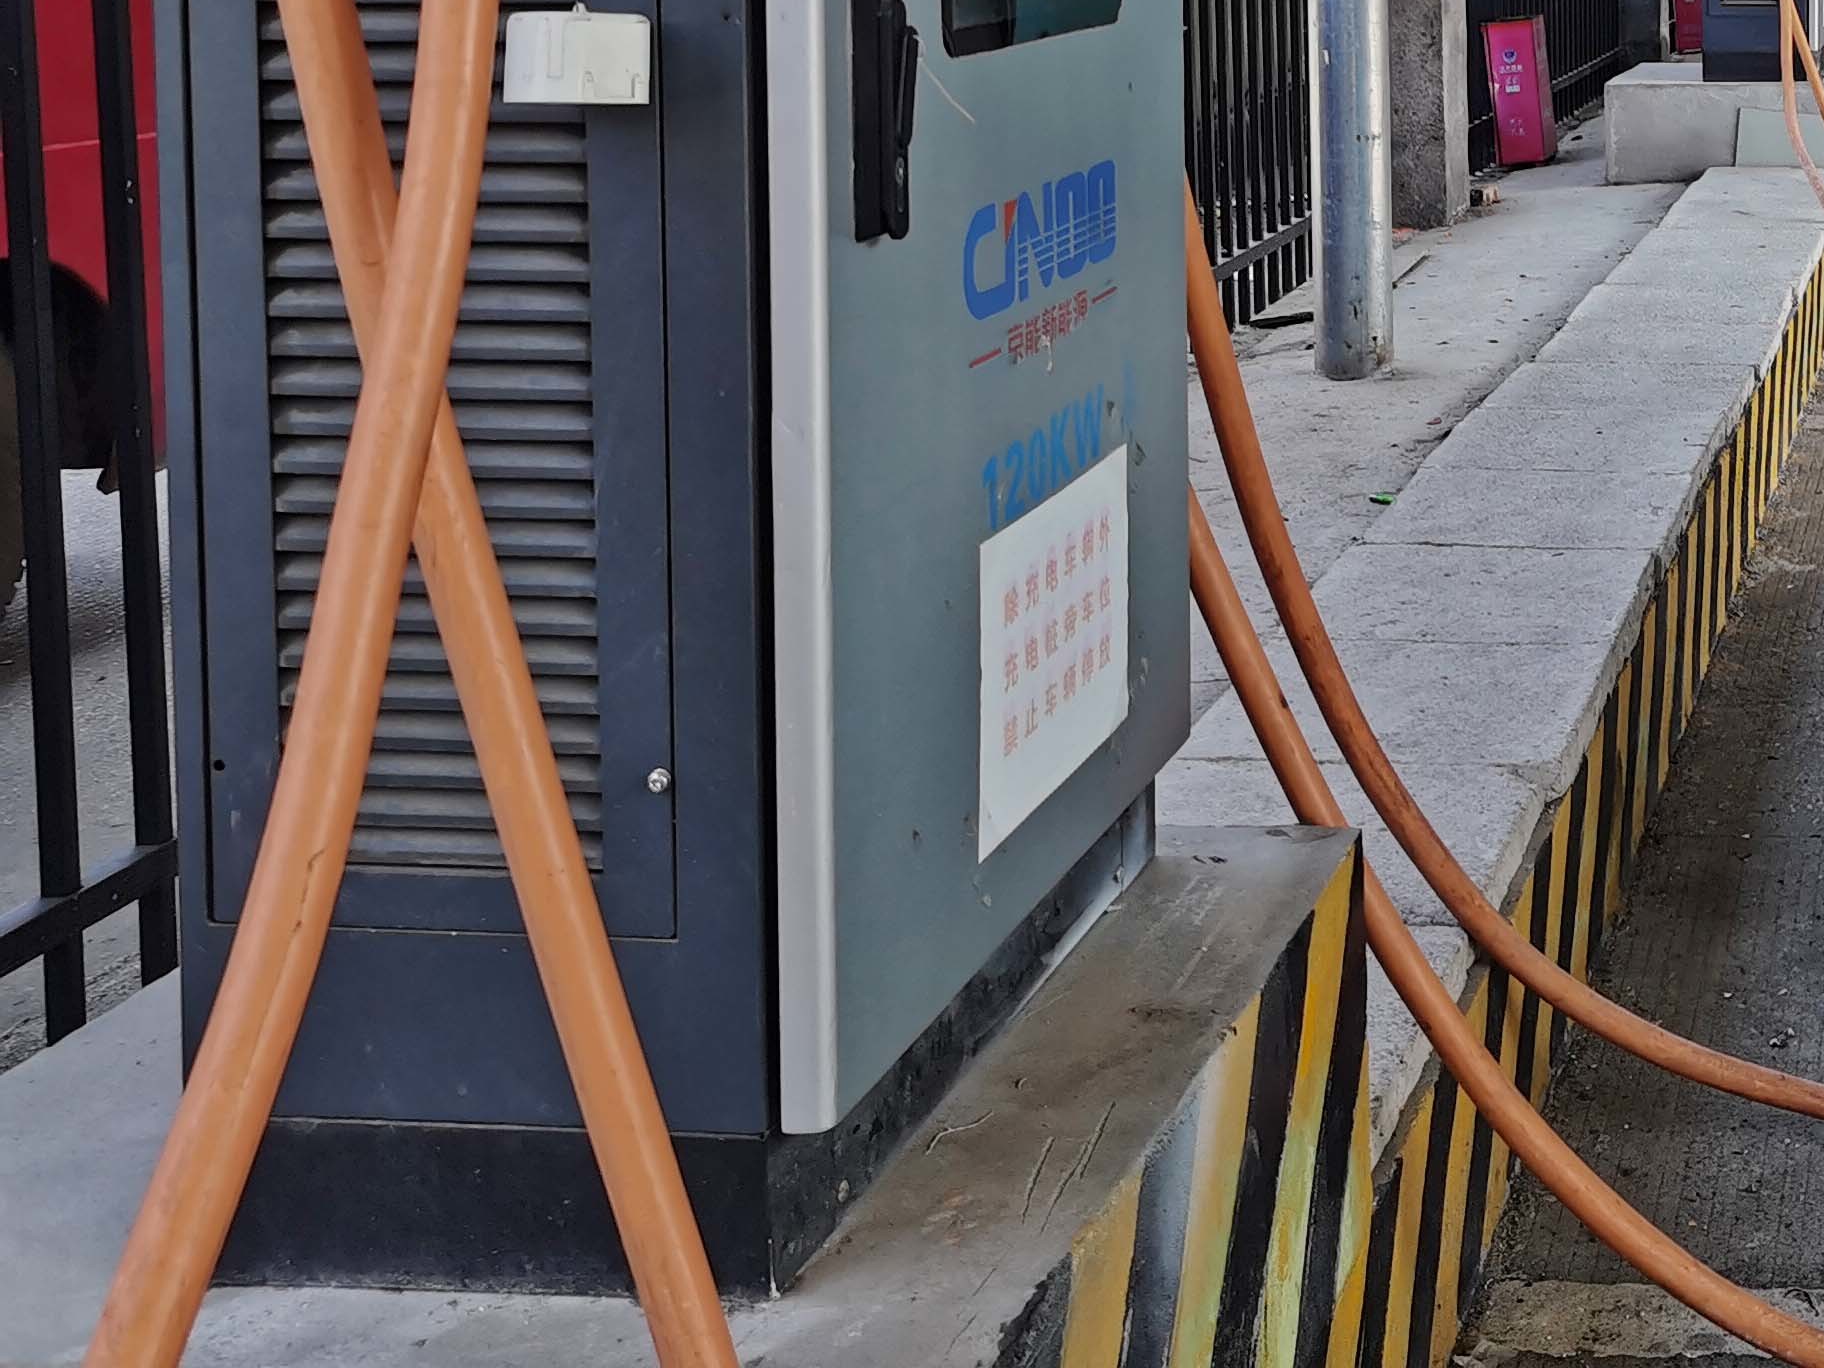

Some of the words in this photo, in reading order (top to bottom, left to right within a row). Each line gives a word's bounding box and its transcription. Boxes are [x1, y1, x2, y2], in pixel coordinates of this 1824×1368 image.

[982, 383, 1104, 532] 120KW
[1003, 633, 1111, 757] 禁止车辆停放
